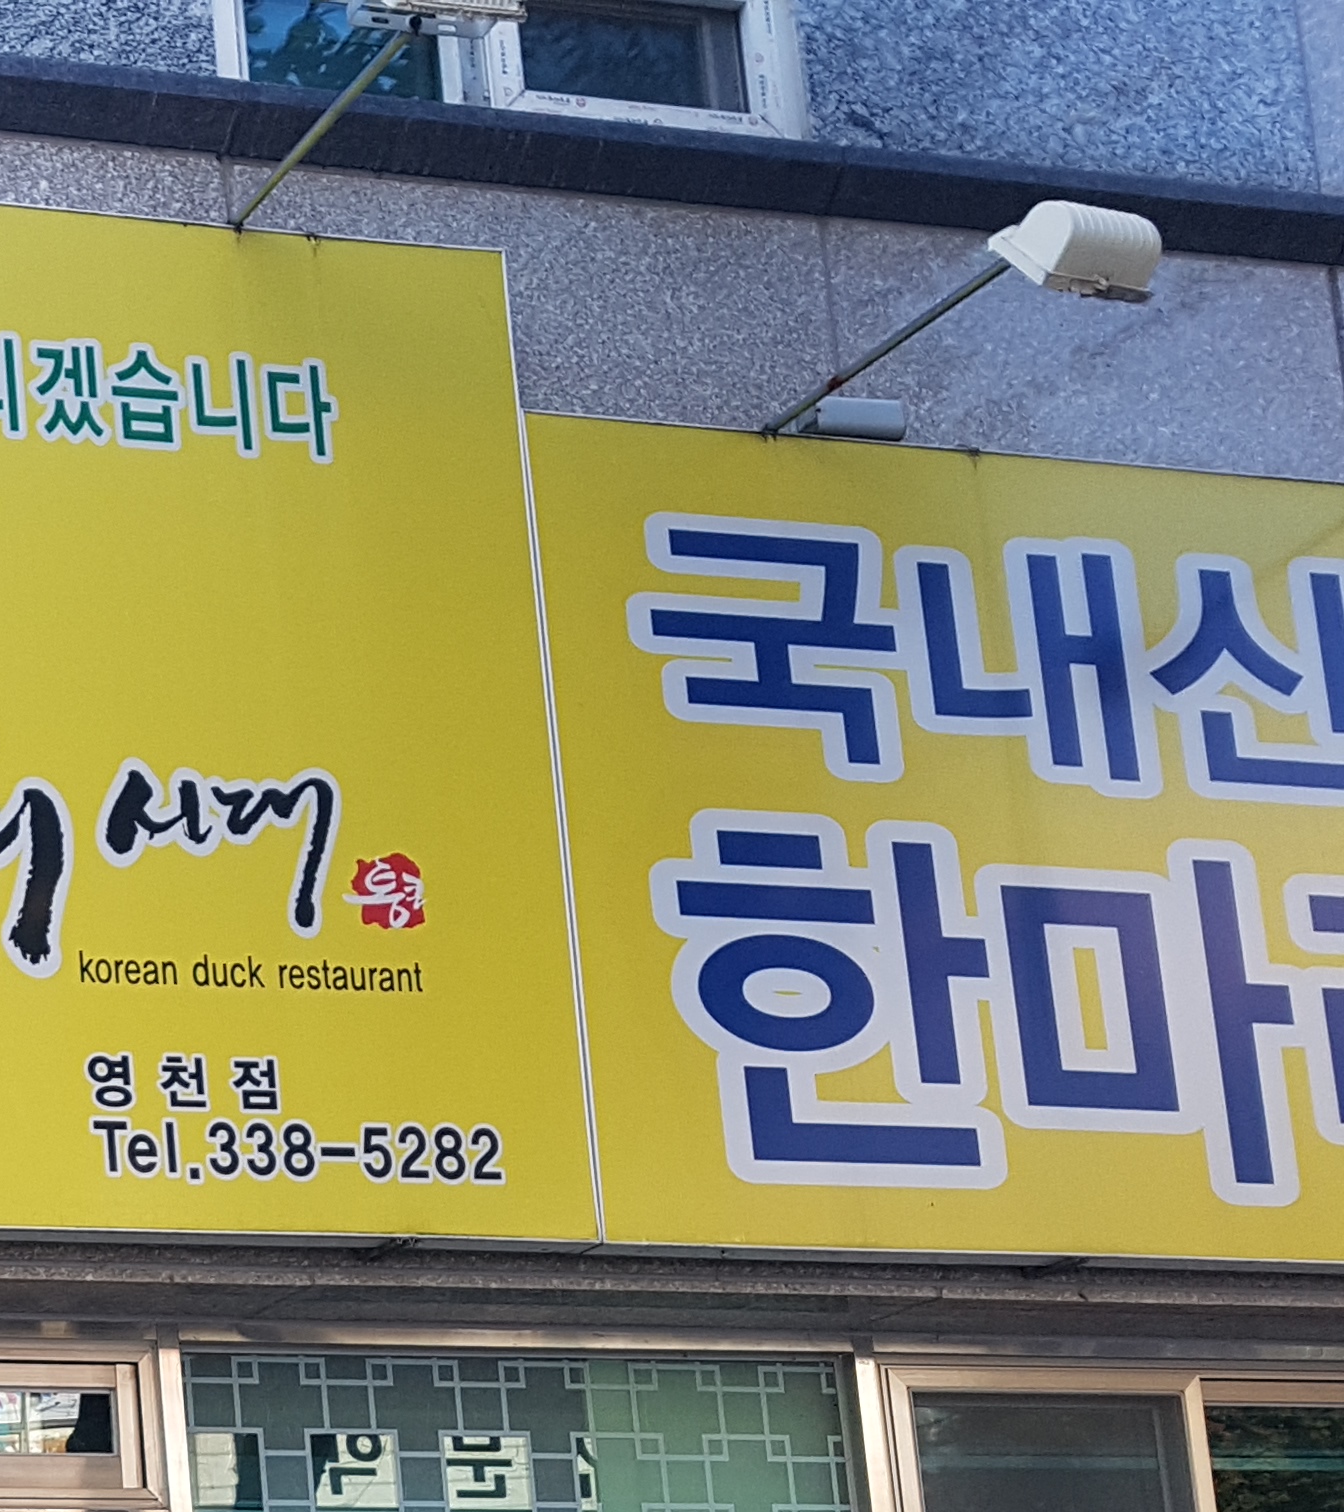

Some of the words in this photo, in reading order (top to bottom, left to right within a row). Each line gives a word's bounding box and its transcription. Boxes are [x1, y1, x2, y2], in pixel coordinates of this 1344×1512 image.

[104, 767, 331, 930] 시대
[79, 952, 178, 988] korean
[192, 956, 266, 989] duck
[278, 960, 423, 993] restaurant
[676, 830, 1344, 1185] 한마
[94, 1121, 500, 1183] Tel.338-5282
